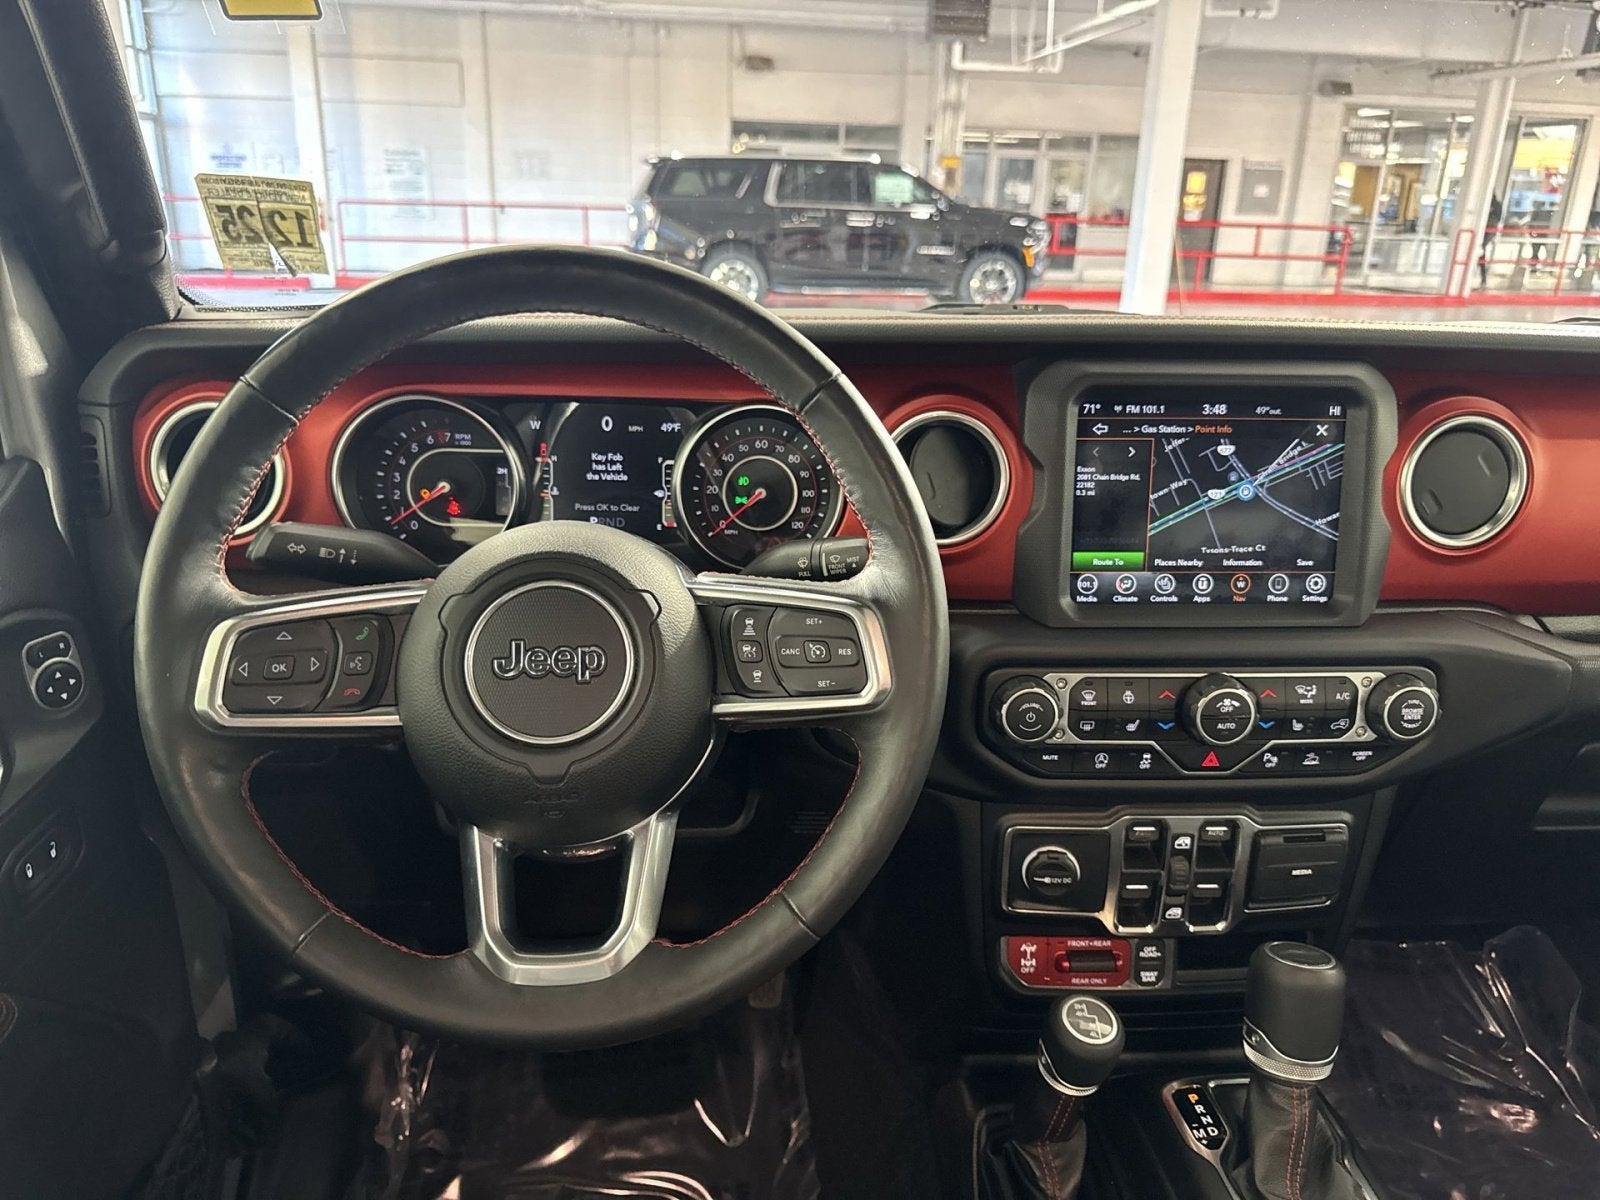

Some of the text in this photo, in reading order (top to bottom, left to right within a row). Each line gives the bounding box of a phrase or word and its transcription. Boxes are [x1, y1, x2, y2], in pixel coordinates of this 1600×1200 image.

[1126, 405, 1140, 414] FM
[1142, 405, 1165, 414] 101.1
[1202, 404, 1228, 414] 3:48
[1329, 406, 1342, 416] HI
[530, 420, 541, 430] W
[601, 416, 613, 432] 0
[1141, 425, 1158, 434] Gas
[1158, 425, 1186, 434] Station
[1195, 425, 1216, 434] Point
[1216, 425, 1232, 434] Info
[427, 435, 434, 444] 6
[444, 433, 451, 442] 7
[411, 442, 419, 452] 5
[755, 440, 768, 448] 60
[399, 456, 406, 465] 4
[592, 453, 624, 462] Key Fob
[722, 454, 734, 462] 40
[788, 455, 800, 464] 80
[592, 463, 622, 471] has Left
[394, 473, 400, 482] 3
[394, 490, 400, 500] 2
[706, 486, 718, 494] 20
[620, 504, 640, 512] Clear
[410, 520, 419, 530] 0
[493, 640, 606, 682] Jeep
[272, 663, 287, 673] OK
[1187, 1093, 1199, 1104] P
[1194, 1104, 1206, 1114] R
[1200, 1114, 1214, 1125] N
[1192, 1128, 1207, 1139] M
[1206, 1126, 1219, 1136] D
